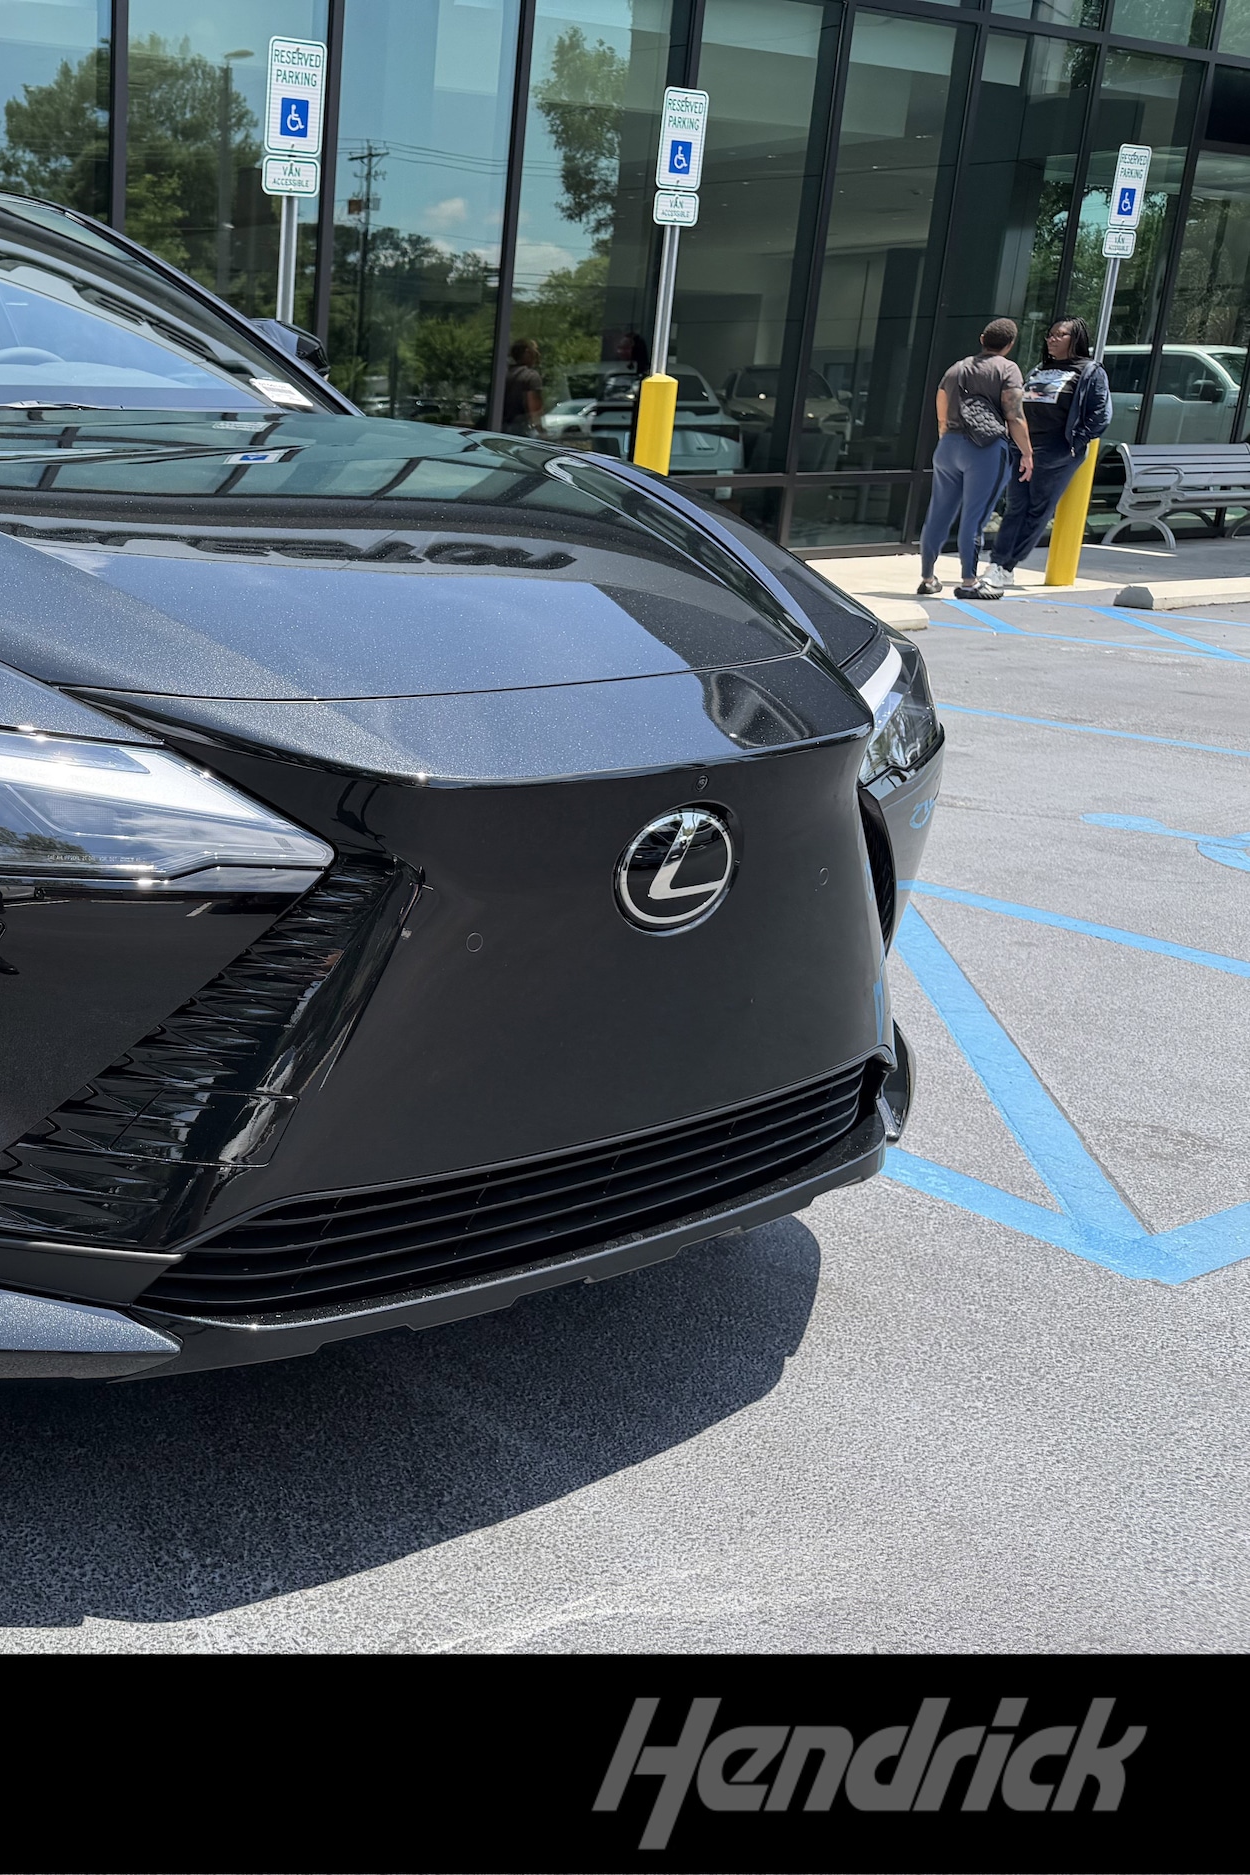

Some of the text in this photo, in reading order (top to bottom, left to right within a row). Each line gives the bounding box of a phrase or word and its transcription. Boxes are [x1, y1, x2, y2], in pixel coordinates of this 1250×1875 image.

[273, 48, 321, 68] RESERVED
[276, 69, 317, 87] PARKING
[667, 98, 704, 115] RESERVED
[667, 115, 700, 131] PARKING
[282, 164, 301, 177] VAN
